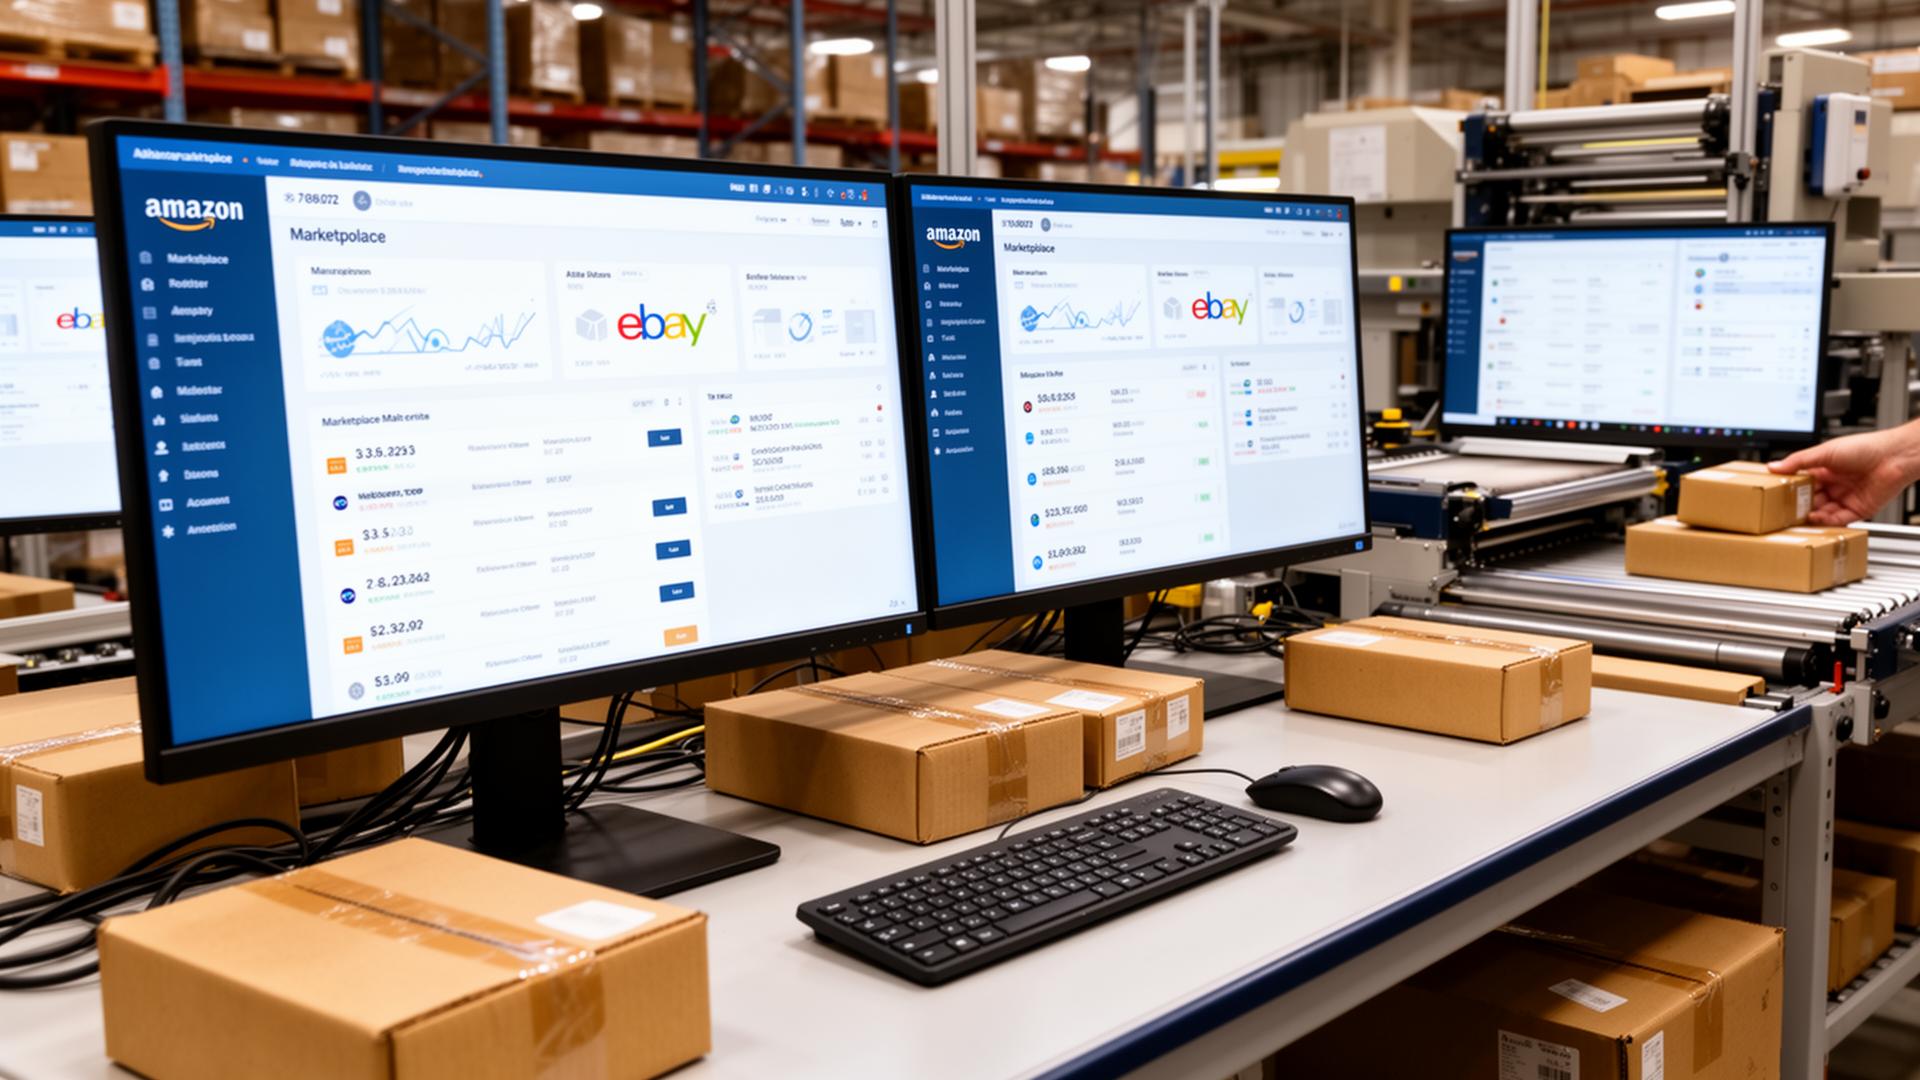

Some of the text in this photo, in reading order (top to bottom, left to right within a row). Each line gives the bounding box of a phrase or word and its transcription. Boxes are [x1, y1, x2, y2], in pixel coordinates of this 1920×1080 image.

[145, 197, 244, 220] amazon
[926, 227, 981, 241] amazon
[1192, 291, 1249, 326] ebay
[617, 303, 707, 347] ebay
